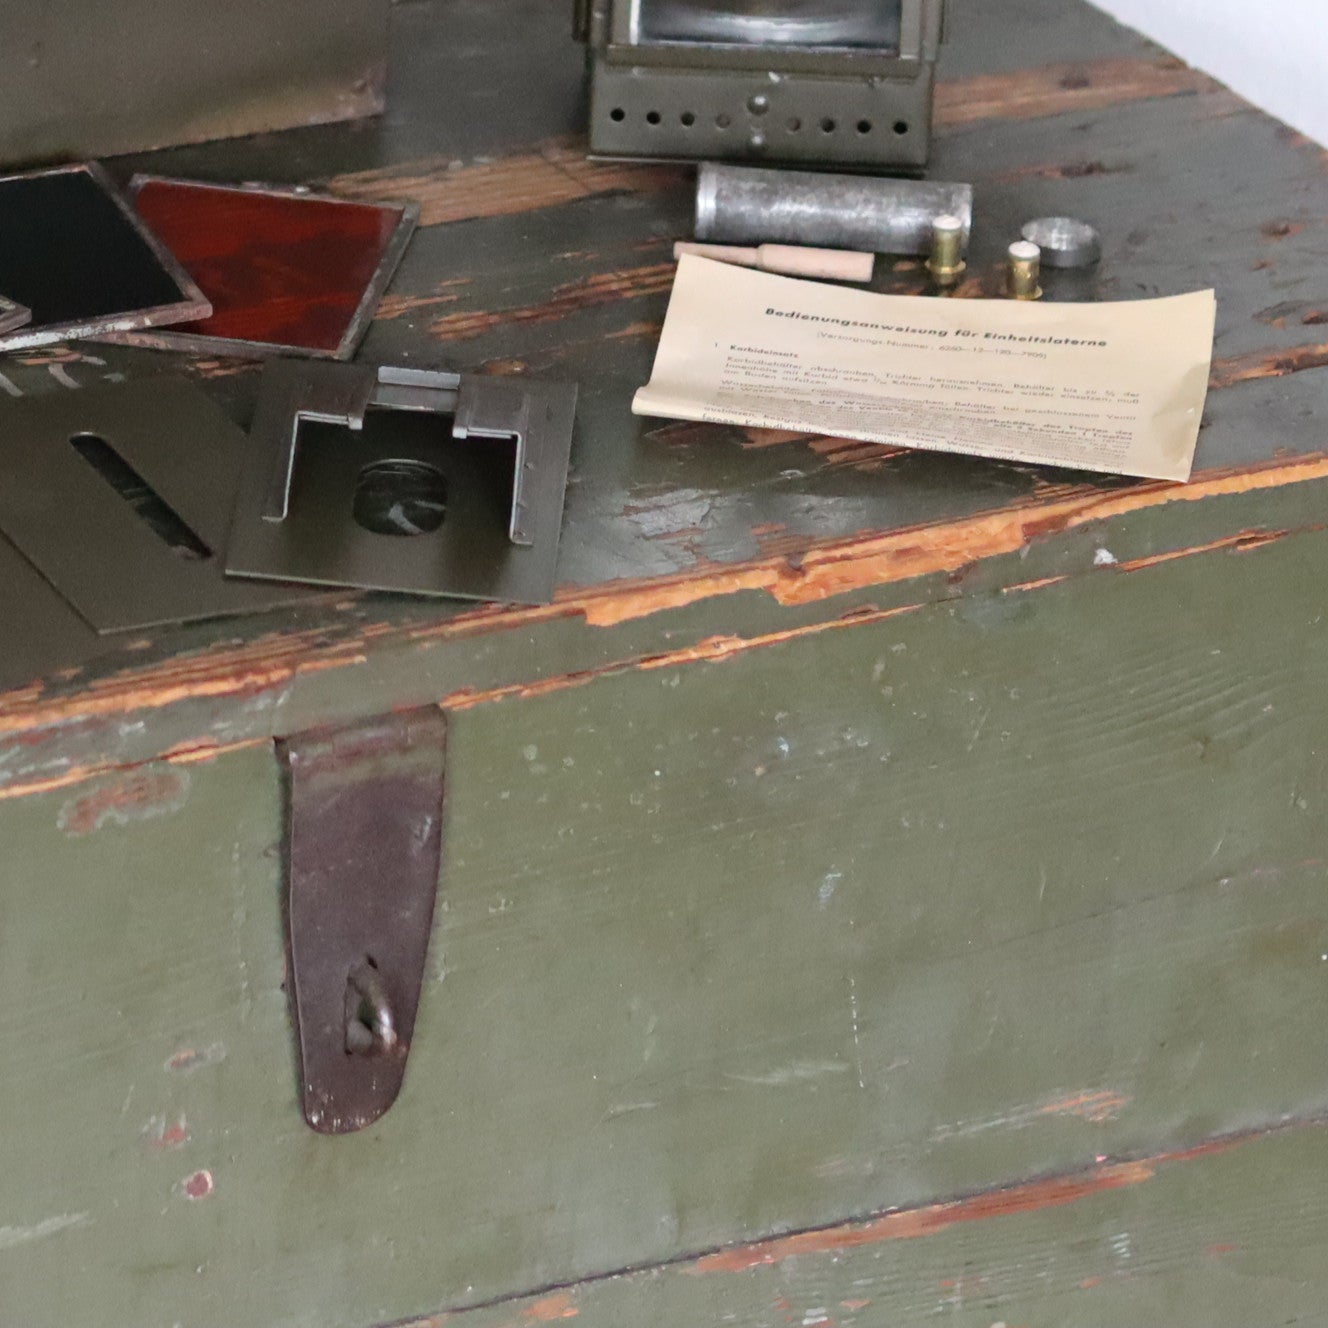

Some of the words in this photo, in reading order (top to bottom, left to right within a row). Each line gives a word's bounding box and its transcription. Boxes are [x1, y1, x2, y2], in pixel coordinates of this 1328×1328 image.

[765, 307, 949, 338] Bedienungsanweisung
[954, 328, 979, 339] für
[983, 331, 1108, 347] Einheitslaterne
